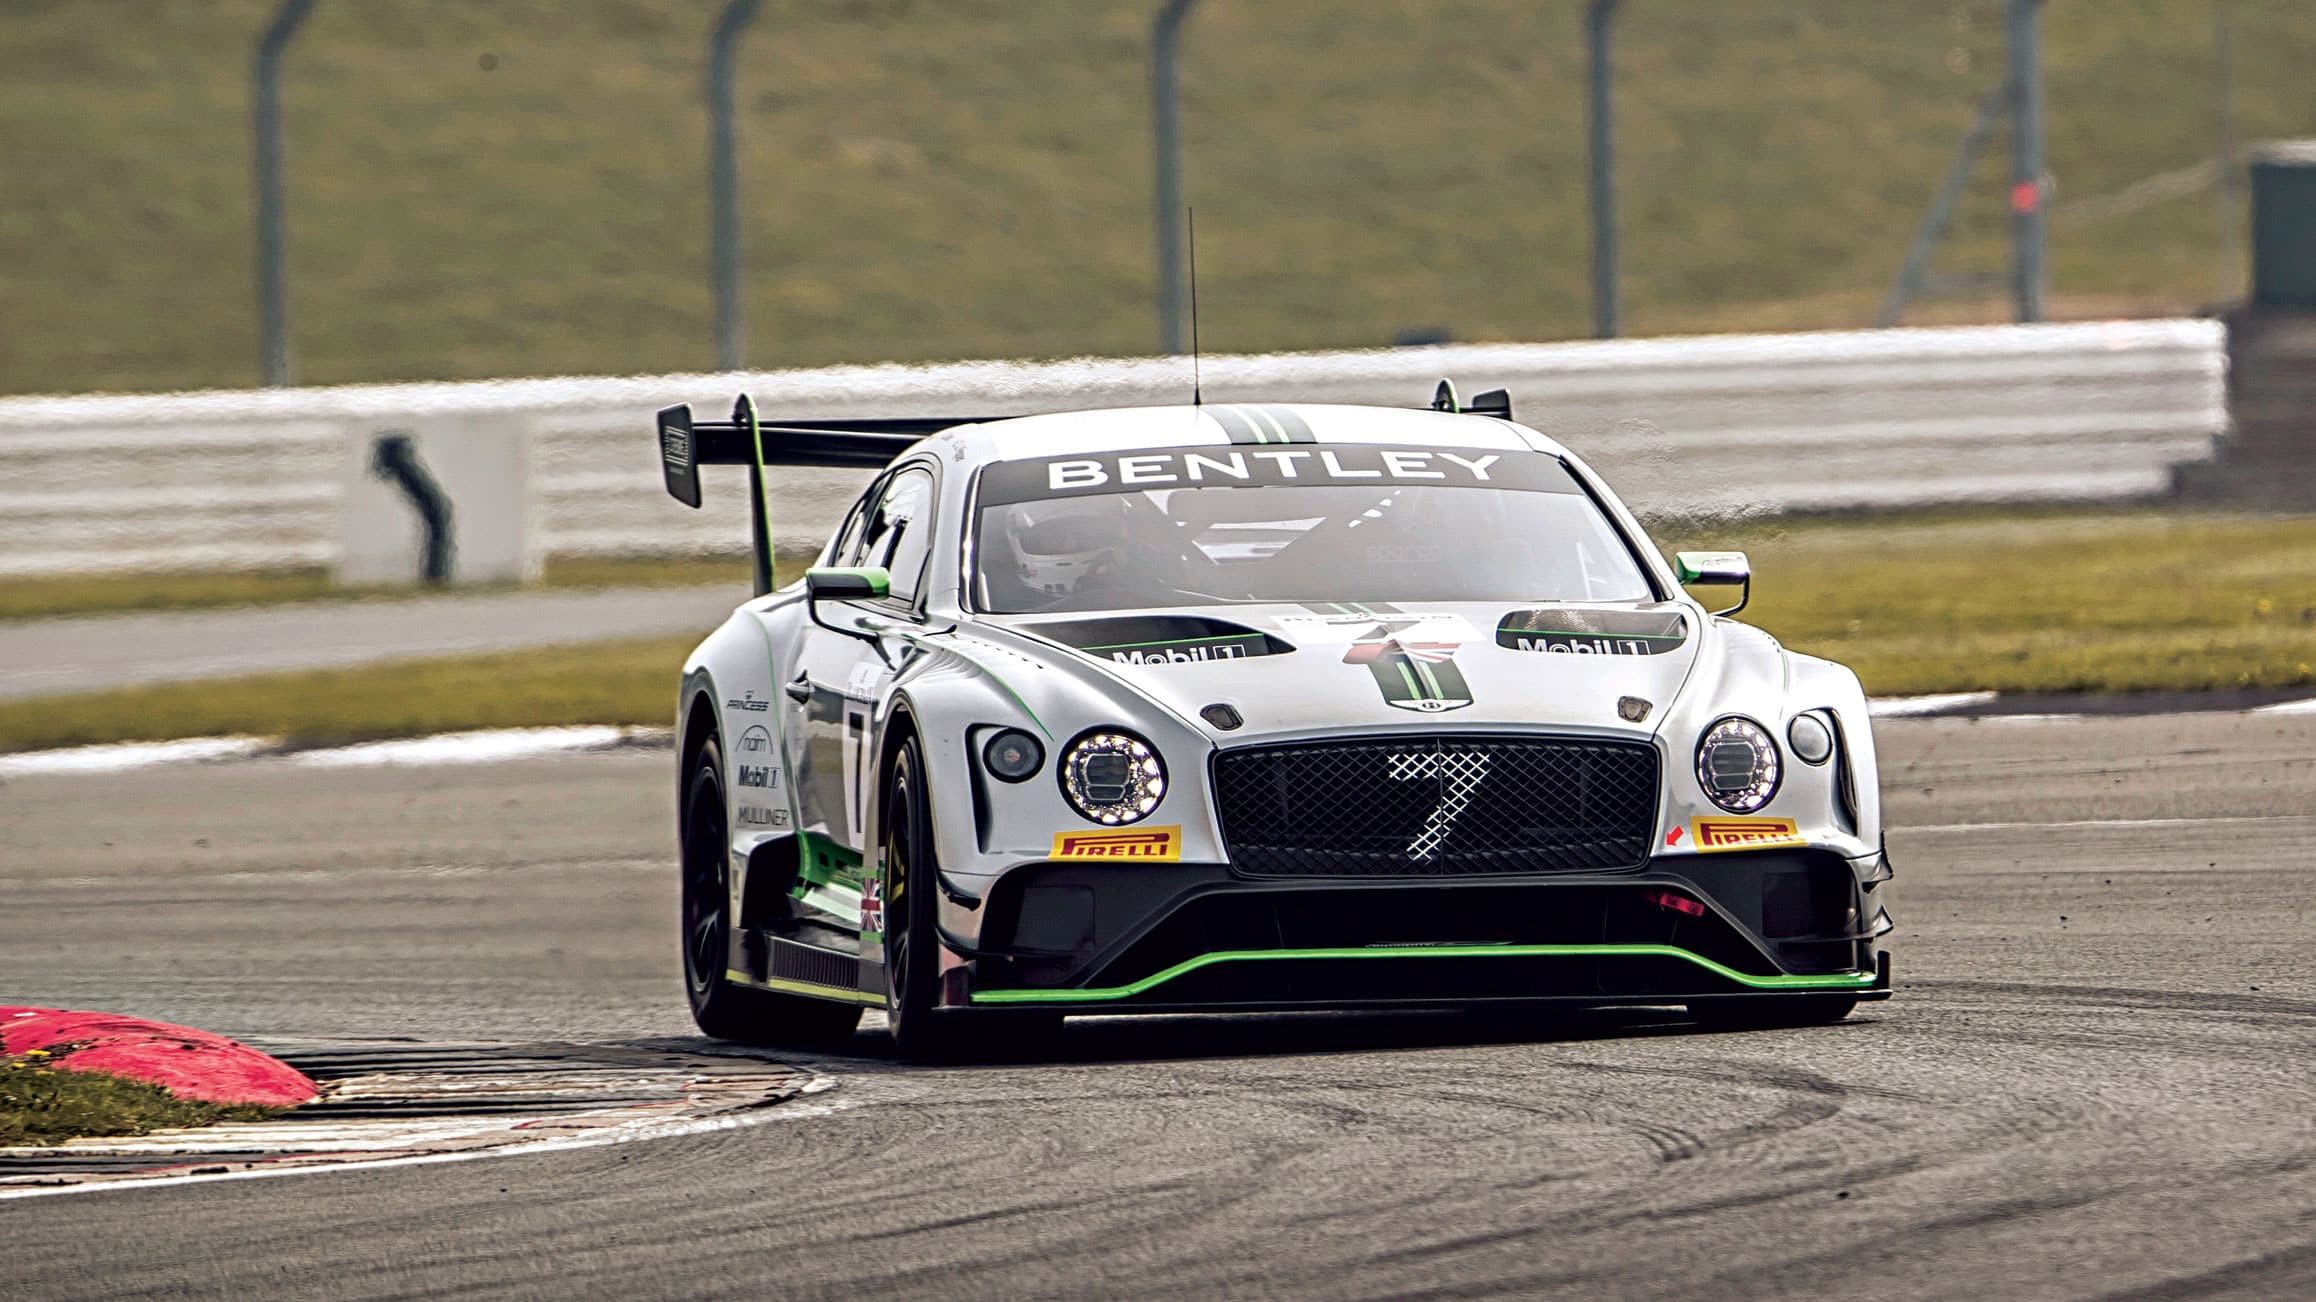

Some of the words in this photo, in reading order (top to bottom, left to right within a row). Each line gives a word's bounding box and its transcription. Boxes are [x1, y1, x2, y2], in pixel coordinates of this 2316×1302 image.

[1048, 450, 1501, 490] BENTLEY
[1111, 645, 1208, 665] Mobil
[1517, 638, 1612, 655] Mobil
[738, 764, 769, 788] Mobil
[848, 711, 865, 833] 7
[737, 806, 789, 826] MULLINER
[1387, 752, 1490, 862] 7
[1060, 832, 1170, 856] PIRELLI
[1700, 822, 1792, 846] PIRELLI
